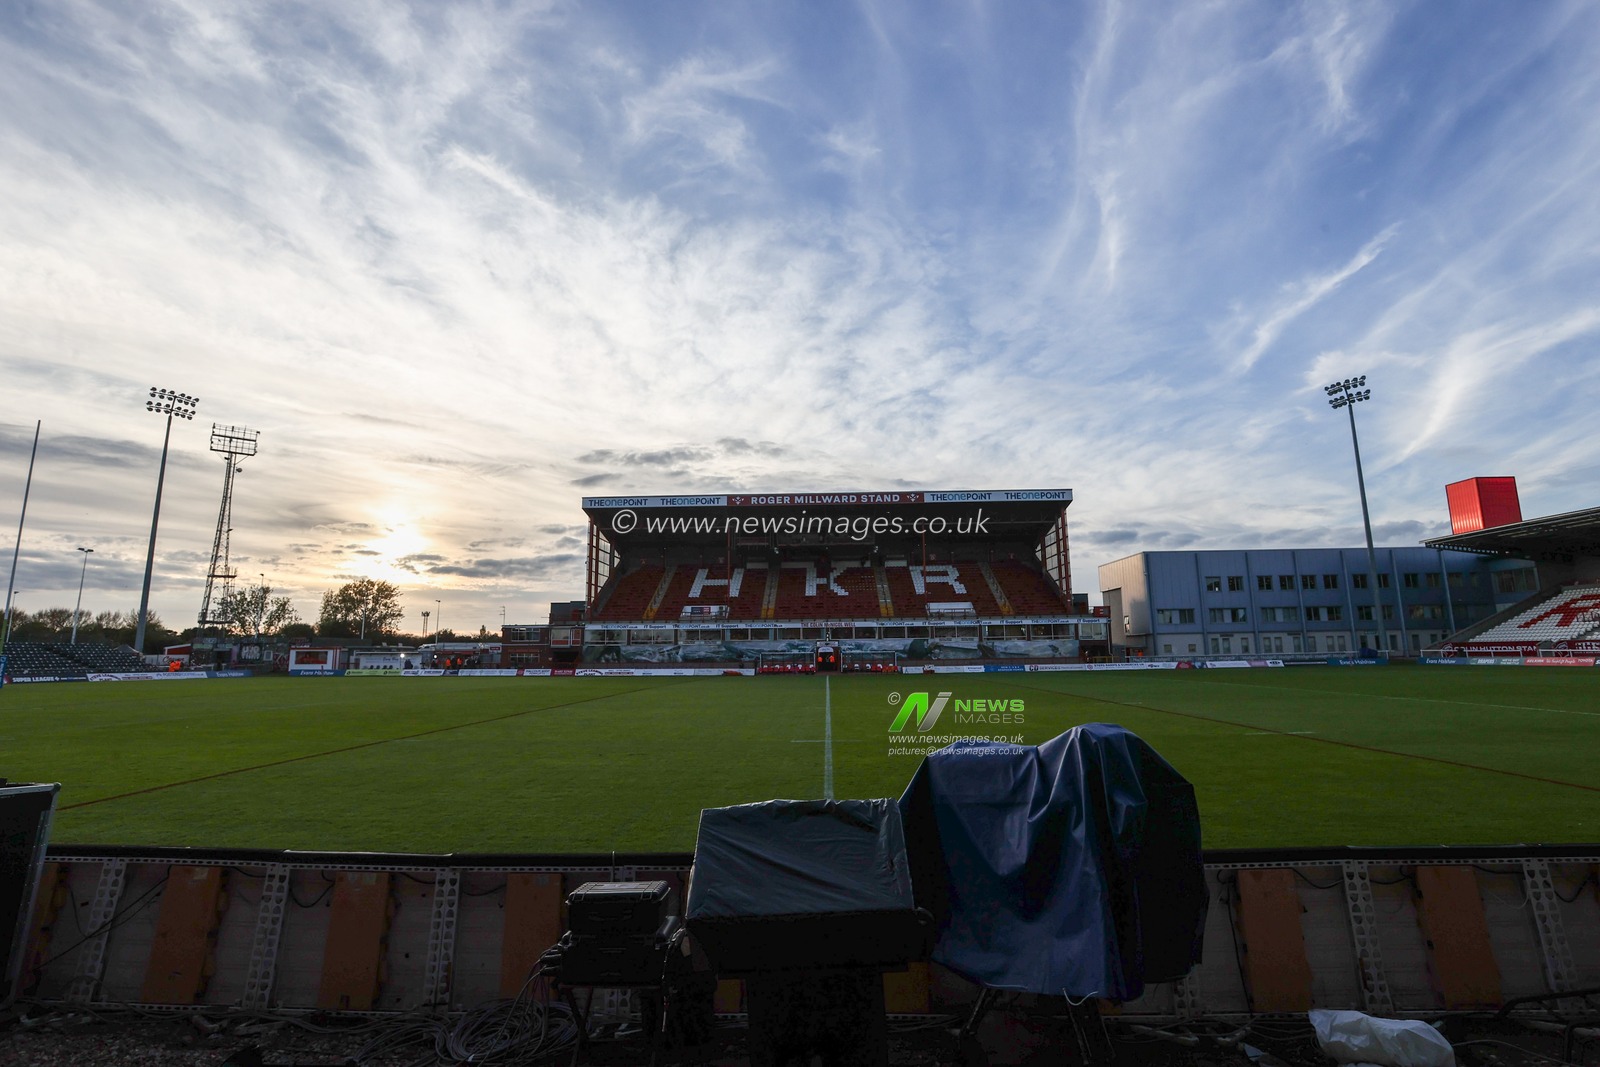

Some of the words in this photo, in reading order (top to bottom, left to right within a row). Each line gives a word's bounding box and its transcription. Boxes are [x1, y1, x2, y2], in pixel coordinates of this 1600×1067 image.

[750, 496, 790, 504] ROGER
[794, 495, 857, 504] MILLWARD
[860, 494, 900, 503] STAND
